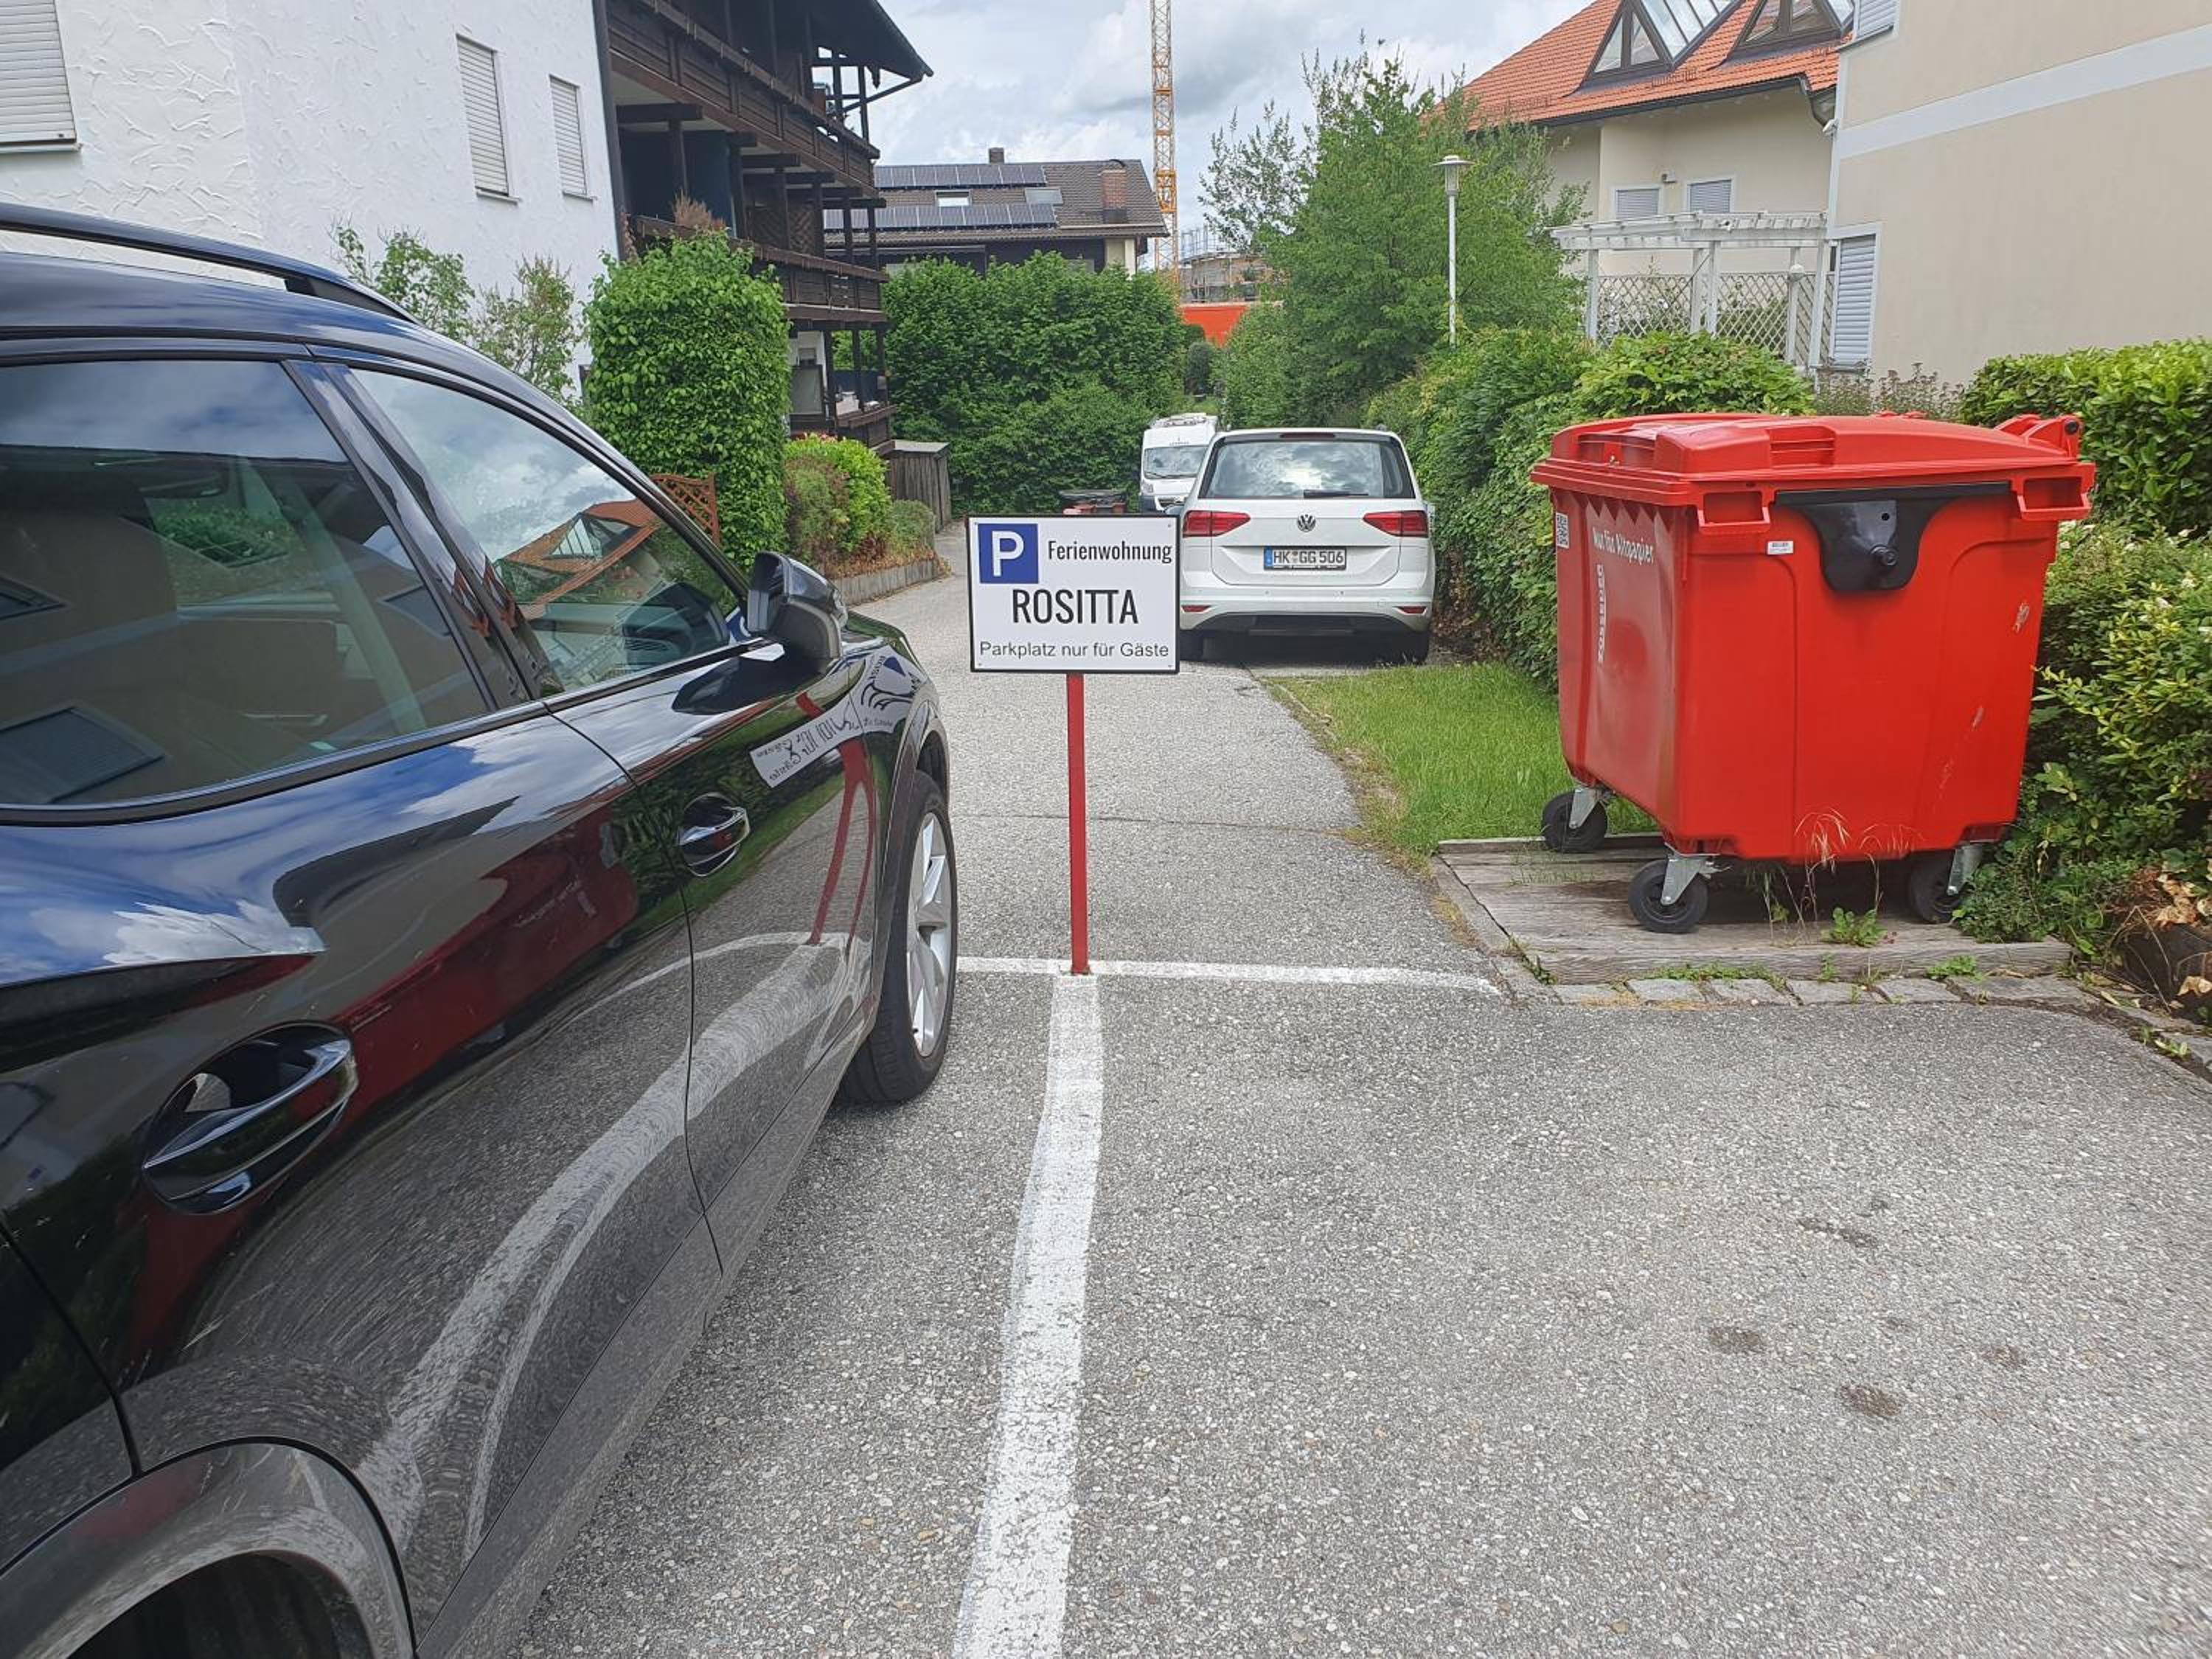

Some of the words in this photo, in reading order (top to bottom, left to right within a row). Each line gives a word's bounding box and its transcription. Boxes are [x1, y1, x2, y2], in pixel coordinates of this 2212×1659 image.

[991, 530, 1024, 577] P
[1048, 540, 1172, 564] Ferienwohnung
[1273, 551, 1290, 564] HK
[1299, 551, 1316, 564] GG
[1319, 551, 1343, 564] 506
[1012, 590, 1138, 624] ROSITTA
[979, 641, 1056, 658] Parkplatz
[1061, 644, 1088, 656] nur
[1093, 642, 1116, 656] für
[1120, 641, 1169, 657] Gäste
